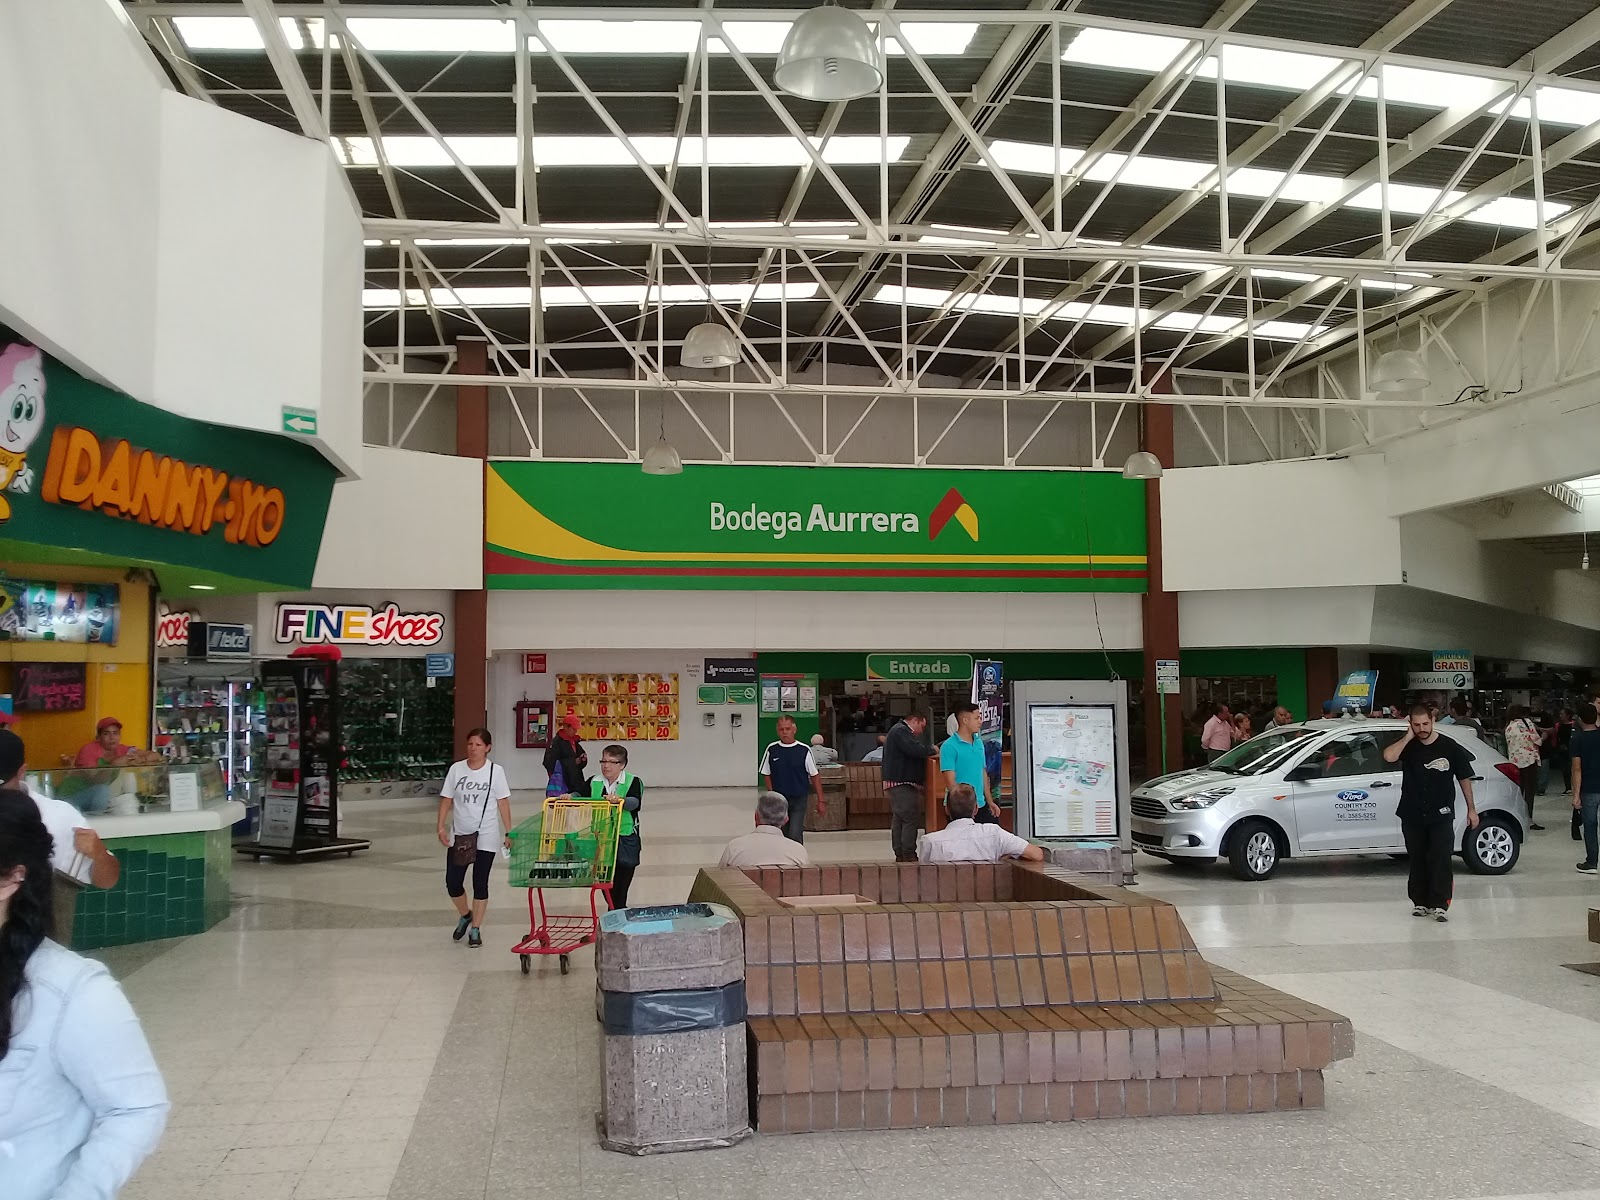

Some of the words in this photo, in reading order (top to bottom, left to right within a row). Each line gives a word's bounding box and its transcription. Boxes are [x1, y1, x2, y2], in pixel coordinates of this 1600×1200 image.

[710, 501, 802, 540] Bodega
[805, 503, 920, 533] Aurrera
[281, 608, 368, 639] FINE
[369, 608, 441, 641] shoes
[889, 659, 951, 674] Entrada
[1434, 661, 1469, 670] GRATIS
[455, 775, 491, 791] Aero
[463, 793, 480, 804] NY
[1342, 790, 1365, 801] Ford
